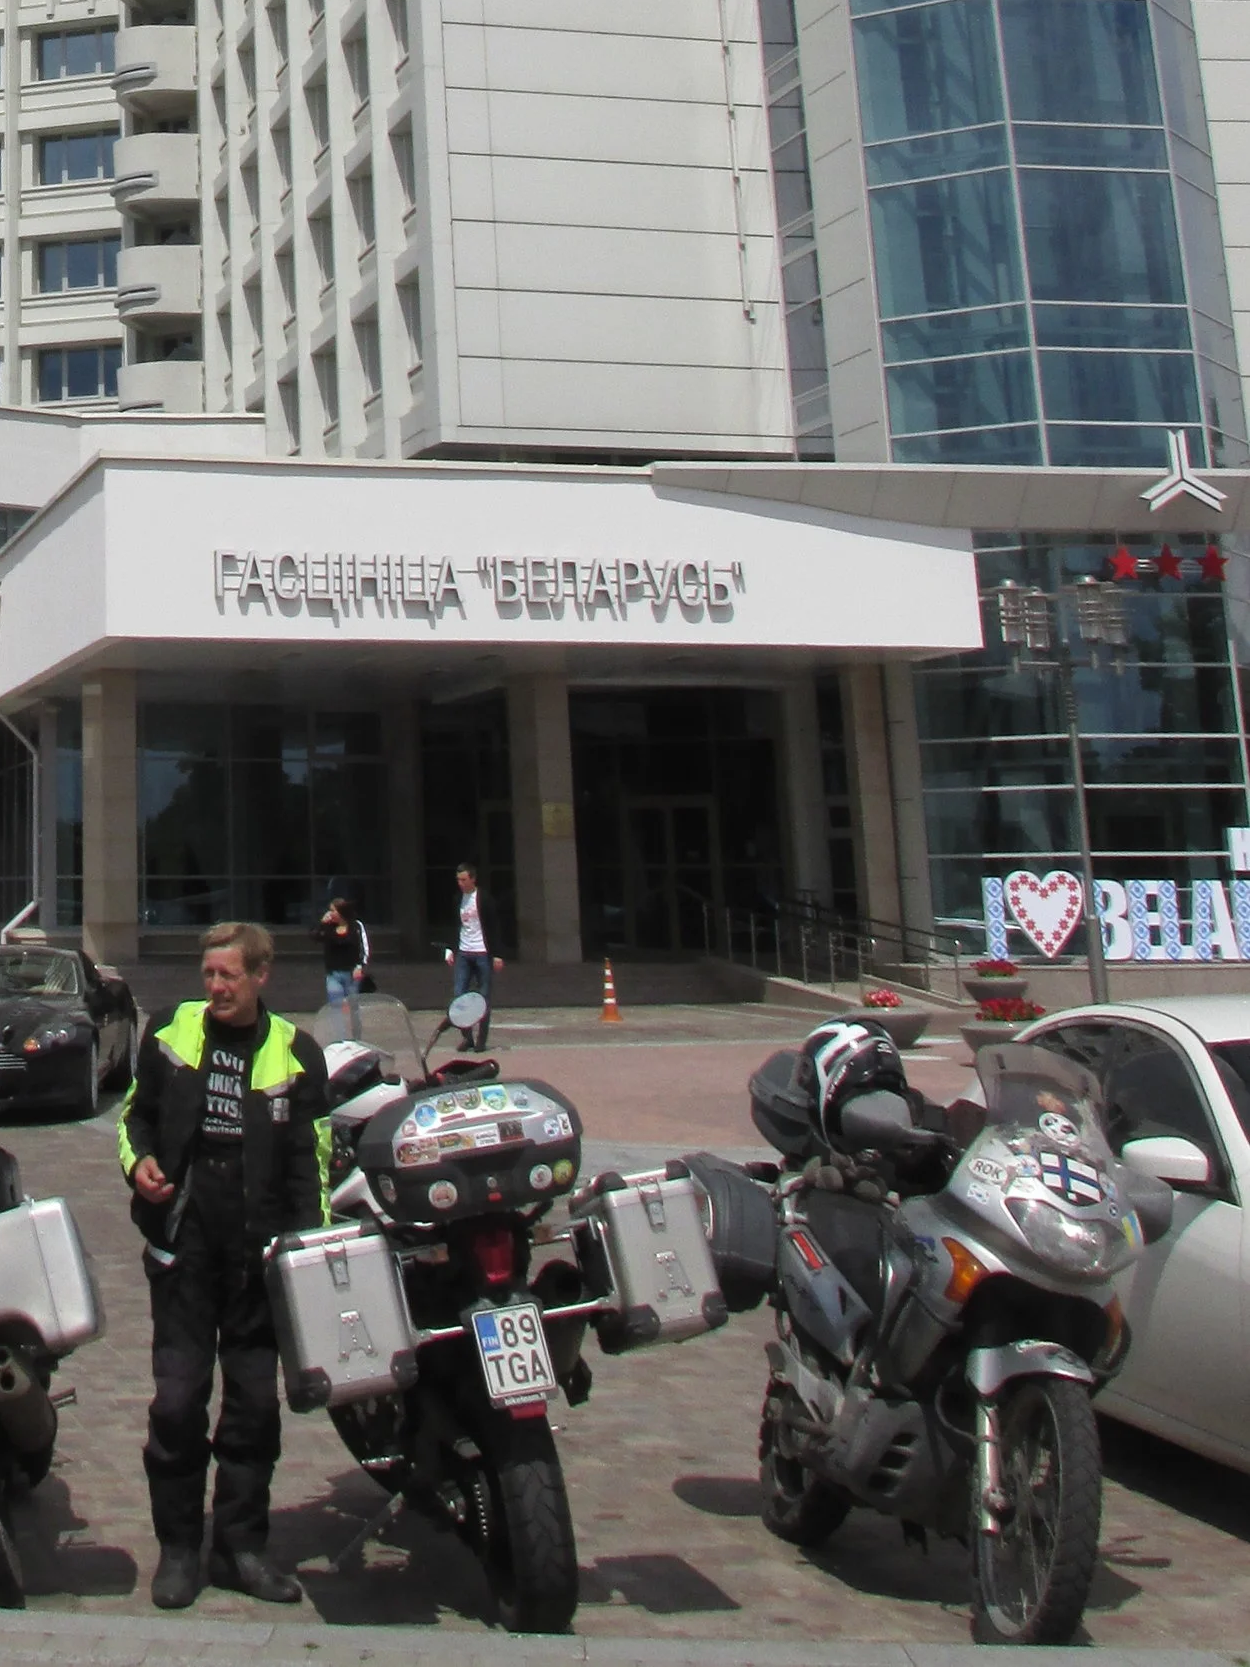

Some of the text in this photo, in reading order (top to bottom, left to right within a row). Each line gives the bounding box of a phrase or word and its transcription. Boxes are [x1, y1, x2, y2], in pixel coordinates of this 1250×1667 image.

[215, 549, 465, 612] ГАСЦІНІЦА
[1083, 878, 1250, 961] BELA
[973, 1161, 1003, 1180] ROK
[500, 1314, 538, 1348] 89
[487, 1349, 549, 1388] TGA
